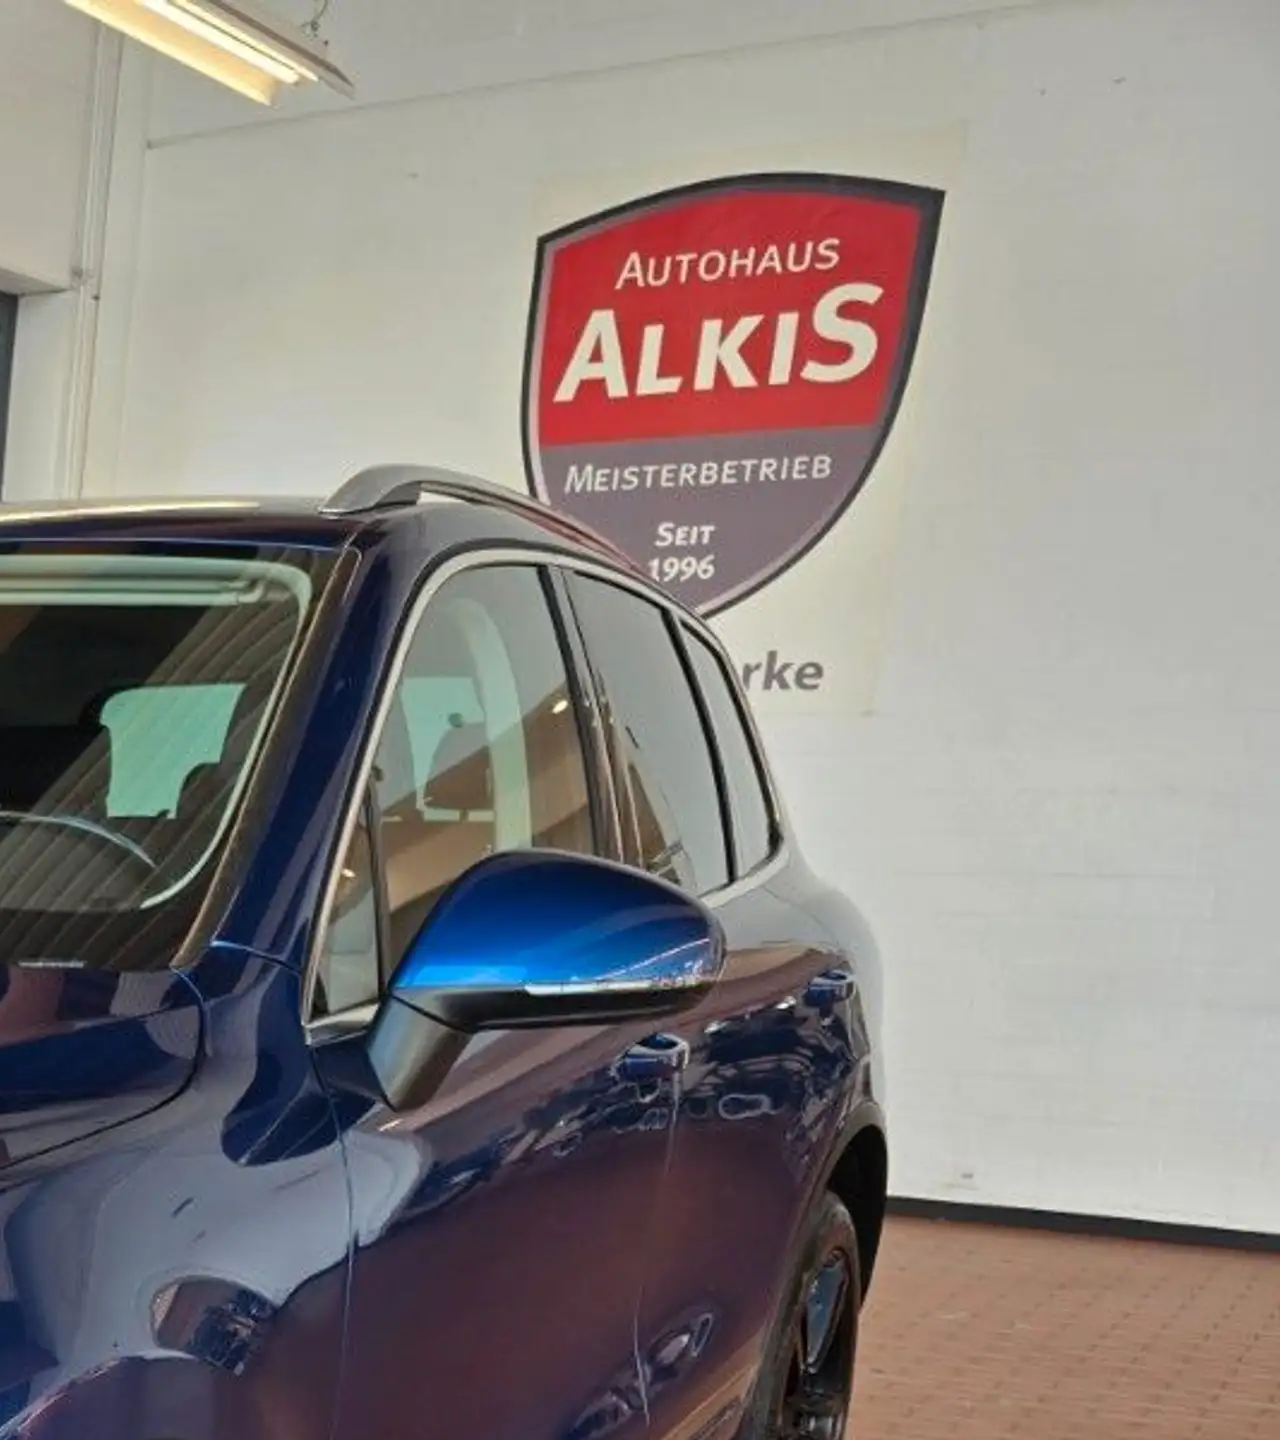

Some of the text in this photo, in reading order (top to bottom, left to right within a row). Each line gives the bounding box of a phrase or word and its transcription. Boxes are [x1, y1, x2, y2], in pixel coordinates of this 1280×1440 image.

[614, 237, 841, 290] AUTOHAUS
[552, 282, 885, 403] ALKIS
[564, 454, 834, 494] MEISTERBETRIEB
[654, 521, 716, 547] SEIT
[647, 554, 716, 583] 1996
